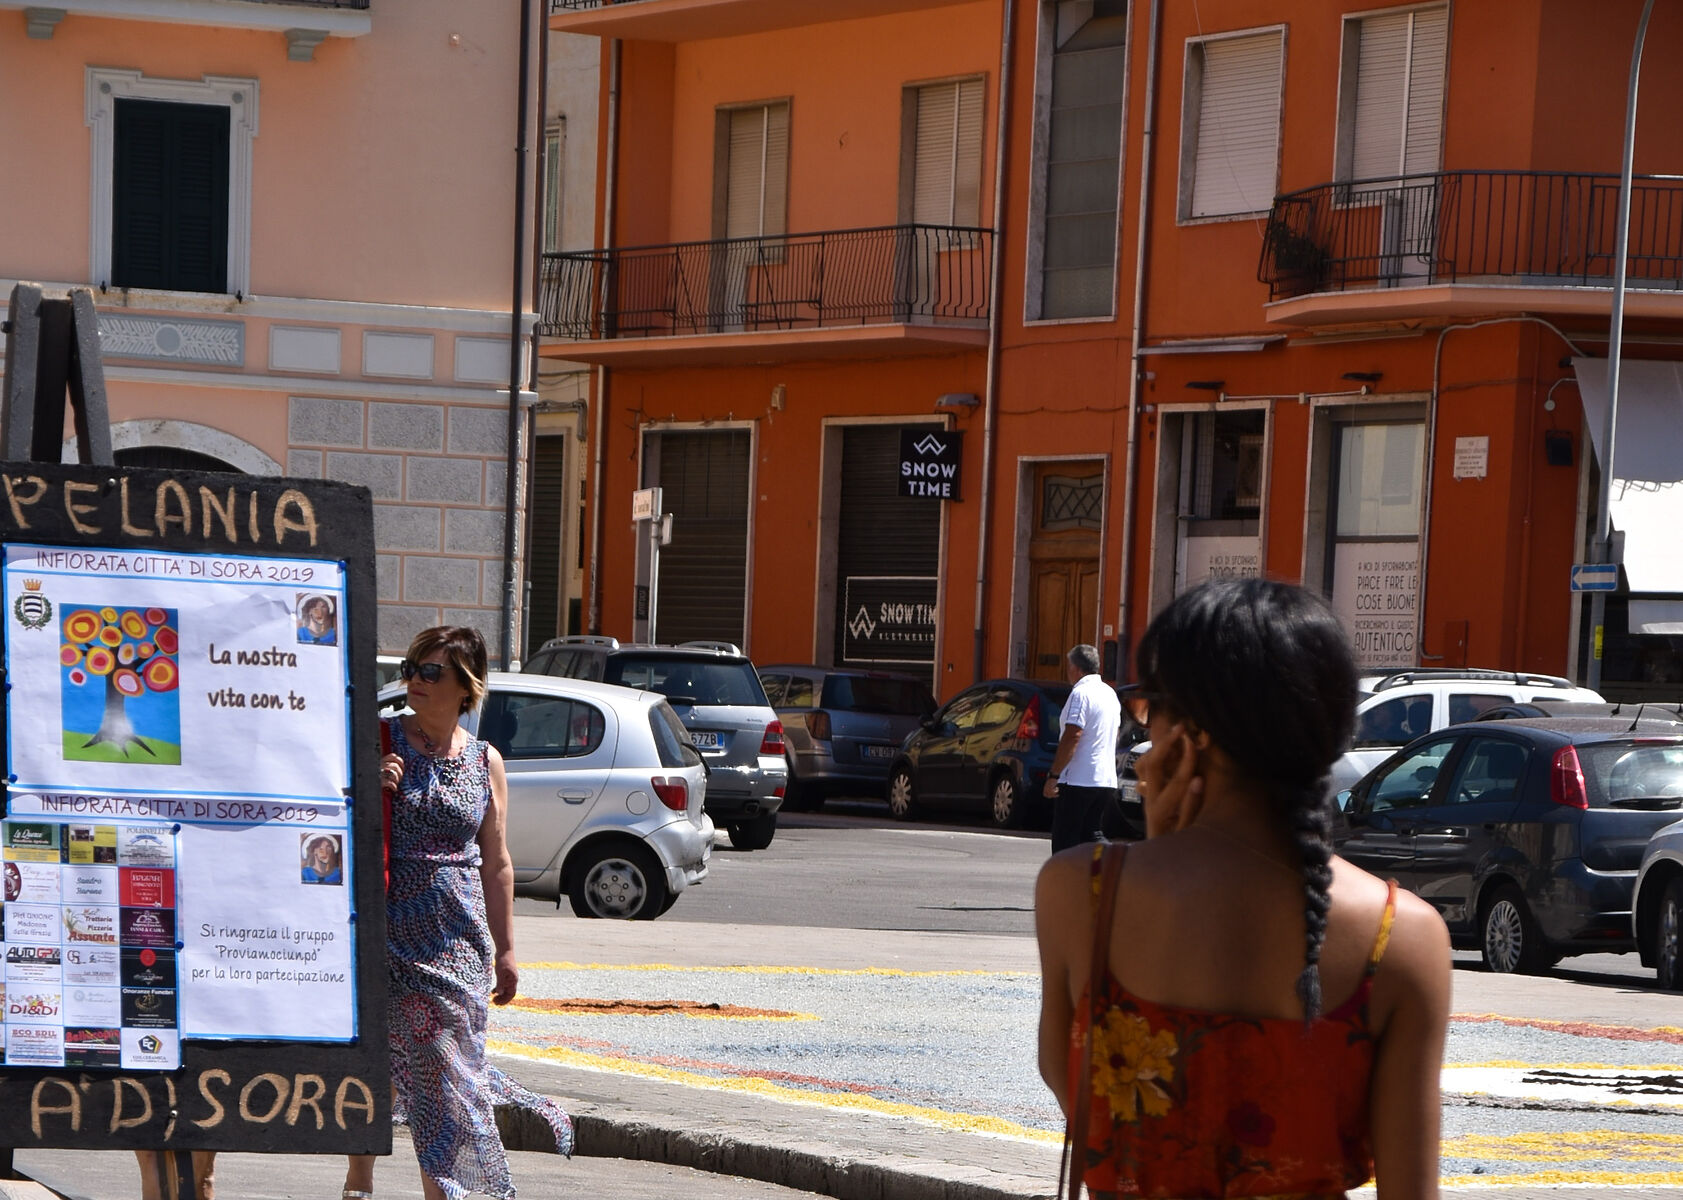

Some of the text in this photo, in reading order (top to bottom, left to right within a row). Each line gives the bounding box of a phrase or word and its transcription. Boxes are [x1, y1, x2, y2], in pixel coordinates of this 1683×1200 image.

[901, 461, 956, 478] SNOW
[908, 481, 951, 497] TIME
[2, 474, 320, 546] PELANIA
[37, 551, 129, 573] INFIORATA
[190, 561, 208, 575] DI
[213, 562, 262, 580] SORA
[268, 566, 315, 583] 2019
[1357, 575, 1417, 590] PIACE FARE LE
[1356, 594, 1415, 610] COSE BUONE
[880, 602, 914, 624] SNOW
[209, 643, 297, 667] La nostra
[208, 688, 306, 711] vita con te
[41, 795, 133, 815] INFIORATA
[194, 804, 211, 818] DI
[215, 804, 267, 821] SORA
[272, 807, 319, 823] 2019
[68, 930, 115, 942] Assunta
[200, 922, 335, 947] Si ringrazia il gruppo
[7, 947, 36, 958] AUTO
[191, 966, 345, 984] per la loro partecipazione
[10, 1004, 58, 1016] DI&DI
[191, 1068, 375, 1131] SORA
